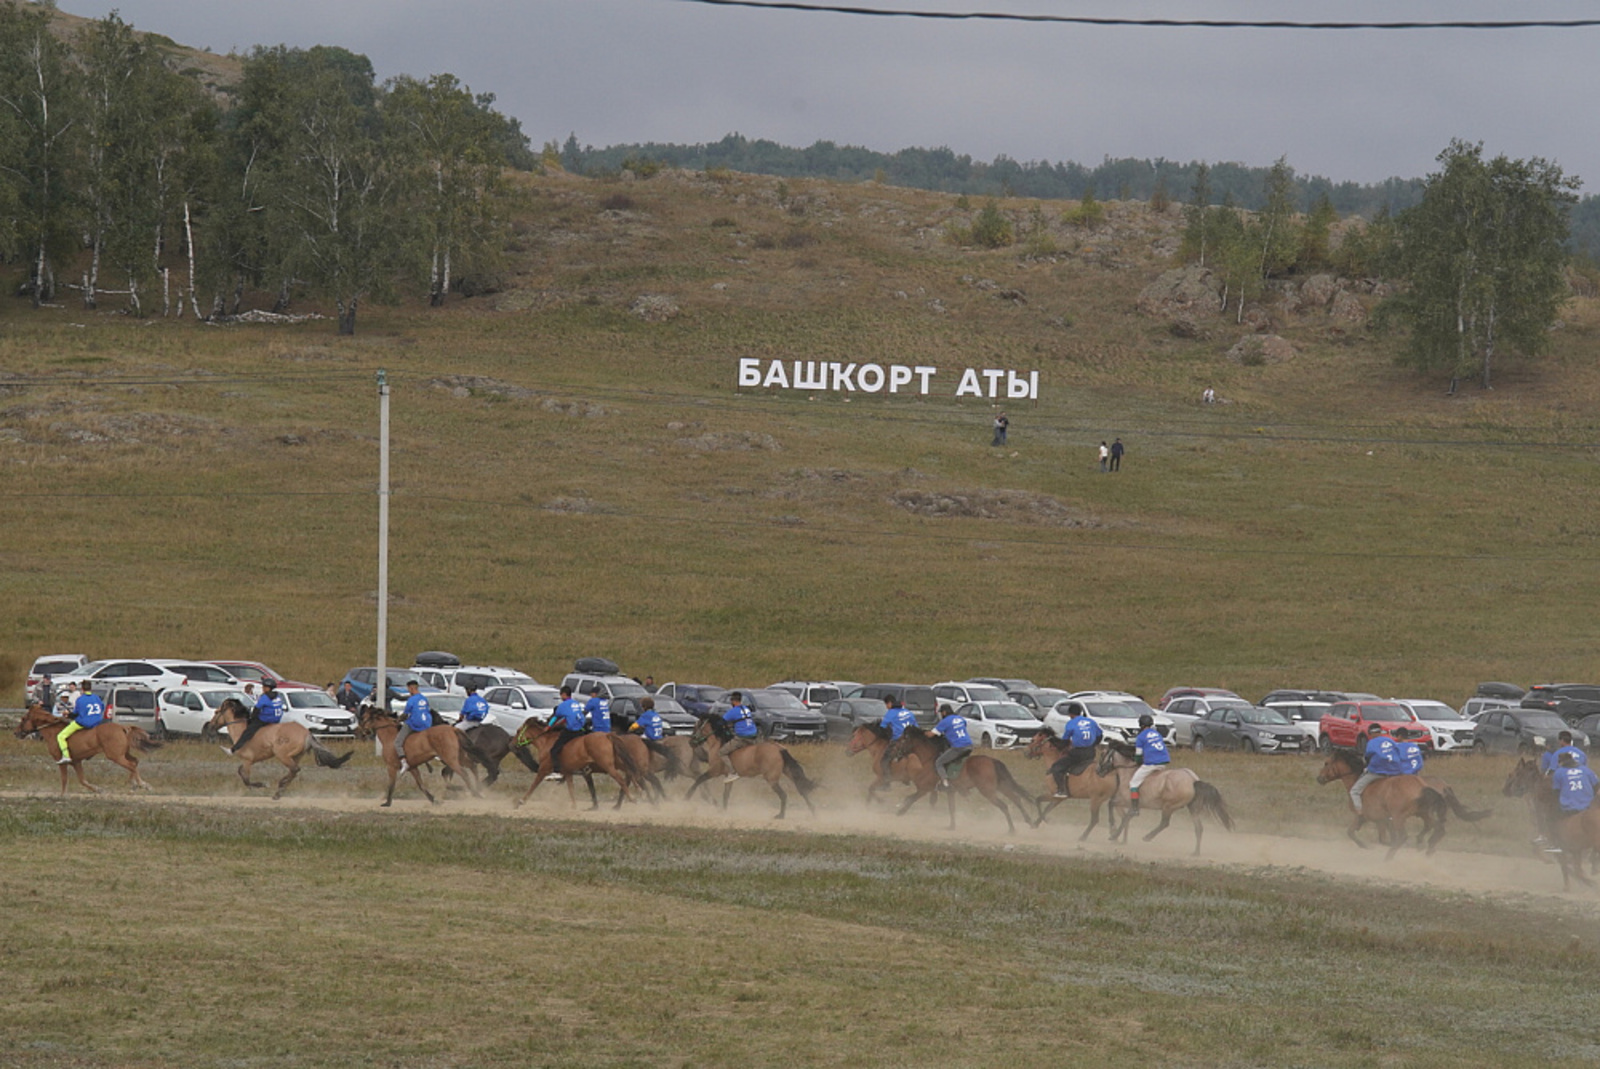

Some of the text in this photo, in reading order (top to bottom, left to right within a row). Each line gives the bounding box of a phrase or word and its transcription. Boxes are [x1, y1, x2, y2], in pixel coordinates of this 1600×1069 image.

[955, 368, 1039, 399] АТЫ
[86, 703, 102, 716] 23
[1410, 759, 1418, 769] 9
[1569, 780, 1583, 791] 24
